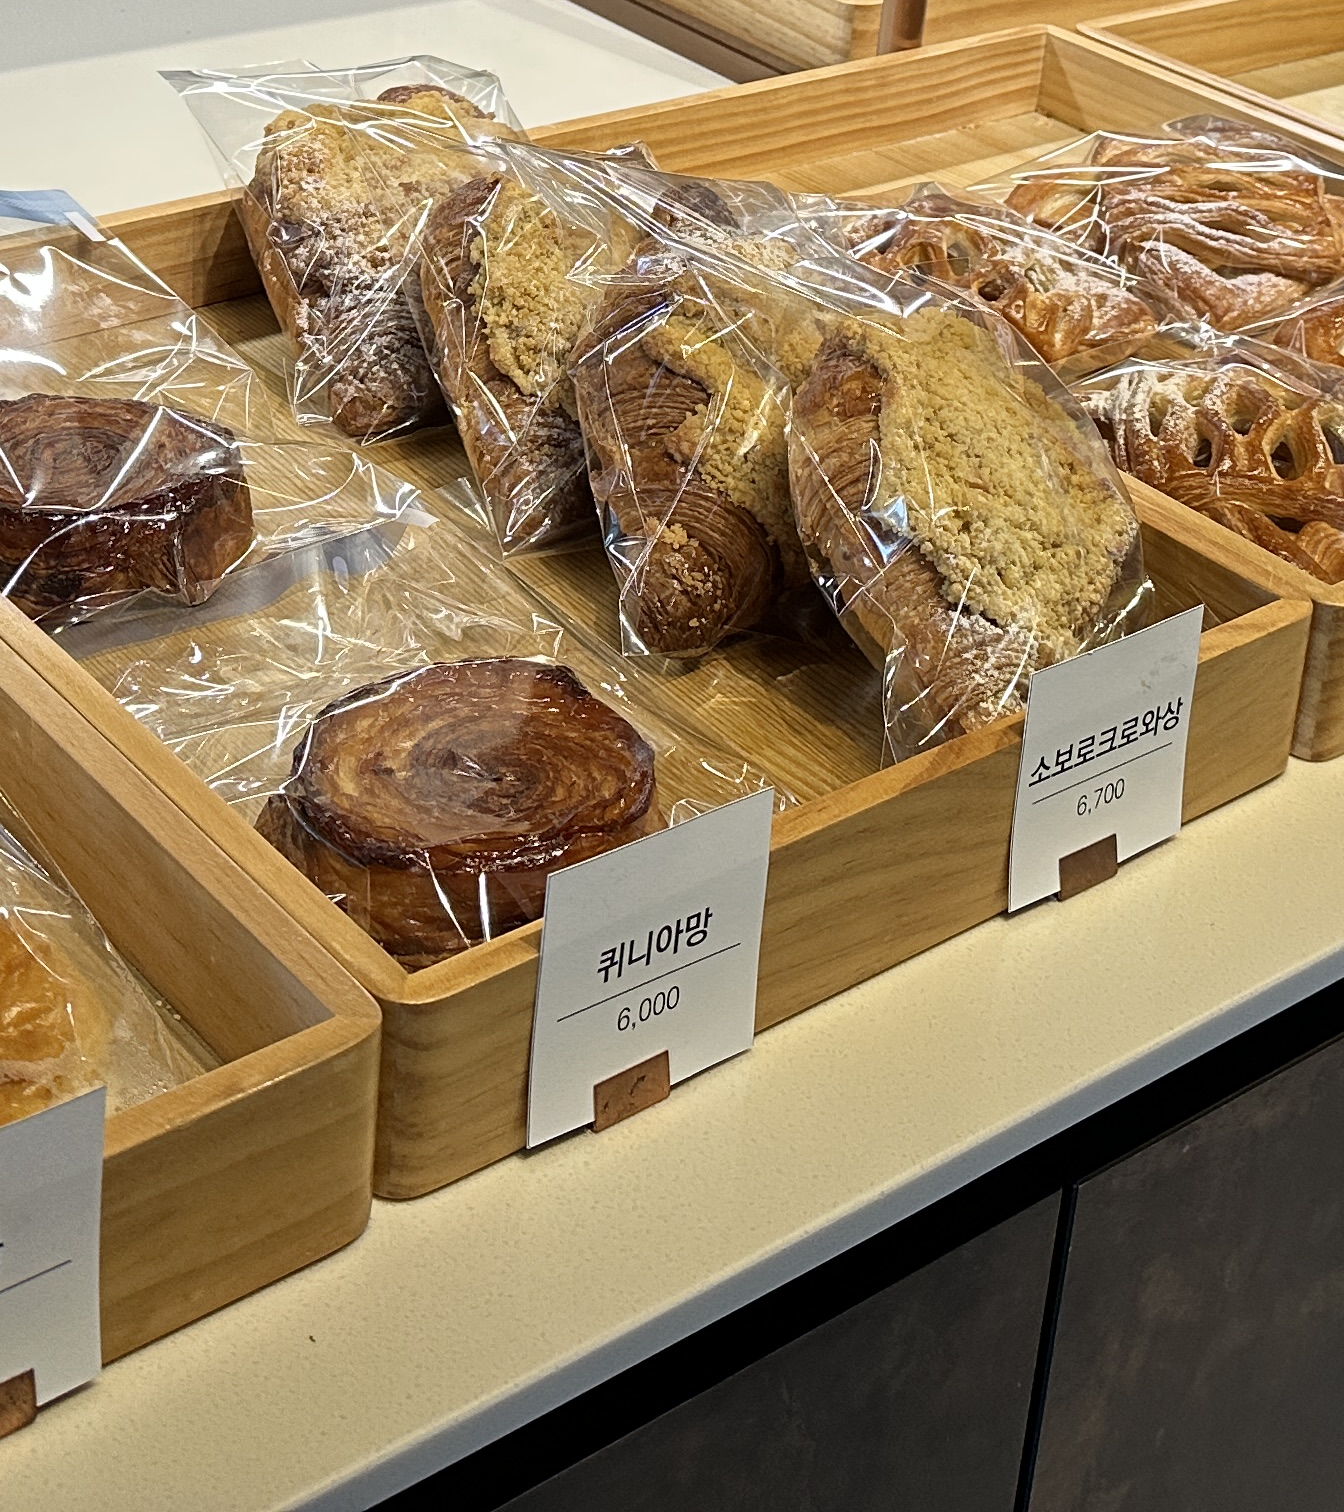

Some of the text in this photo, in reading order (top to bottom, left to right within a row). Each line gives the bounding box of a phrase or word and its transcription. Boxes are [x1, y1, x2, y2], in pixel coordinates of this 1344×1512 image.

[1028, 697, 1184, 788] 소보로크로와상
[1076, 778, 1126, 817] 6,700
[596, 907, 714, 984] 퀴니아망
[616, 985, 681, 1032] 6,000
